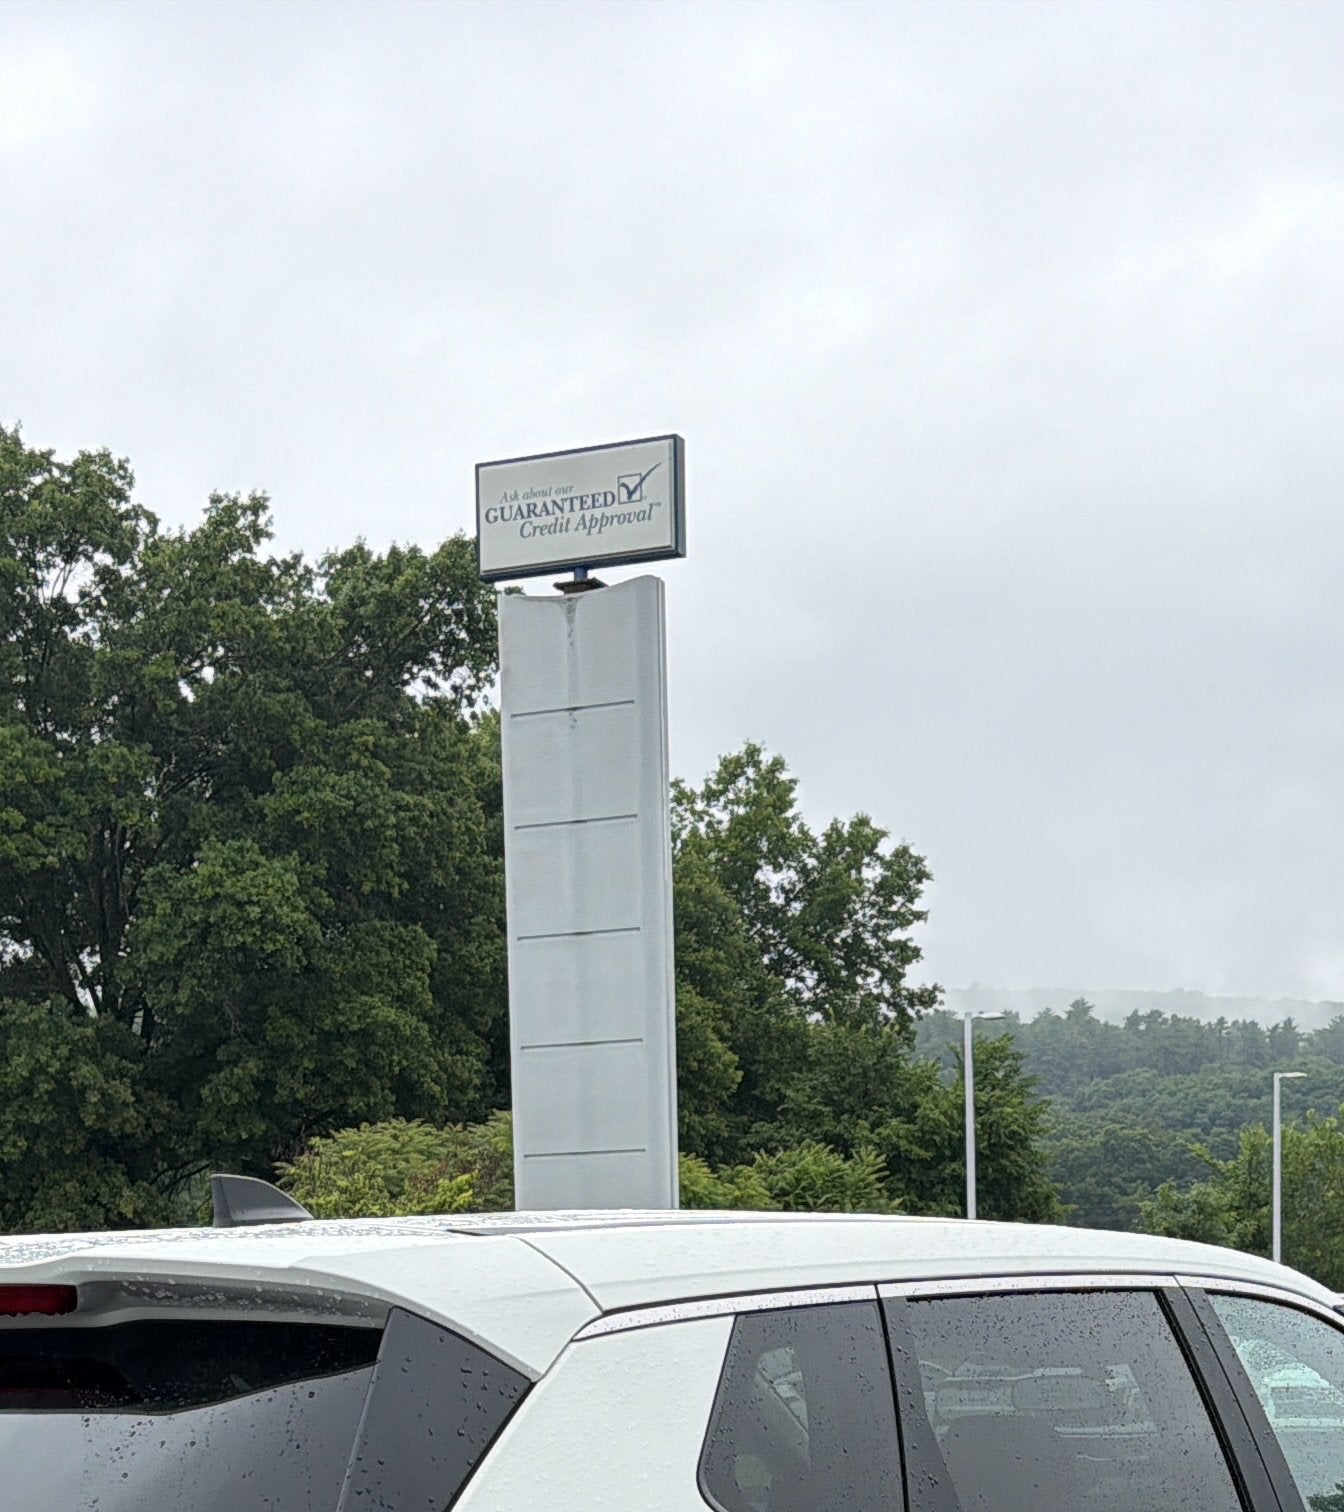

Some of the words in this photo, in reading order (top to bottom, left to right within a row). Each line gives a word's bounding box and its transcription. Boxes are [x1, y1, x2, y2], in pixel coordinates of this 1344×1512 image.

[499, 491, 520, 503] Ask
[522, 486, 552, 501] about
[555, 485, 575, 497] our
[485, 490, 616, 524] GUARANTEED
[520, 517, 570, 539] Credit
